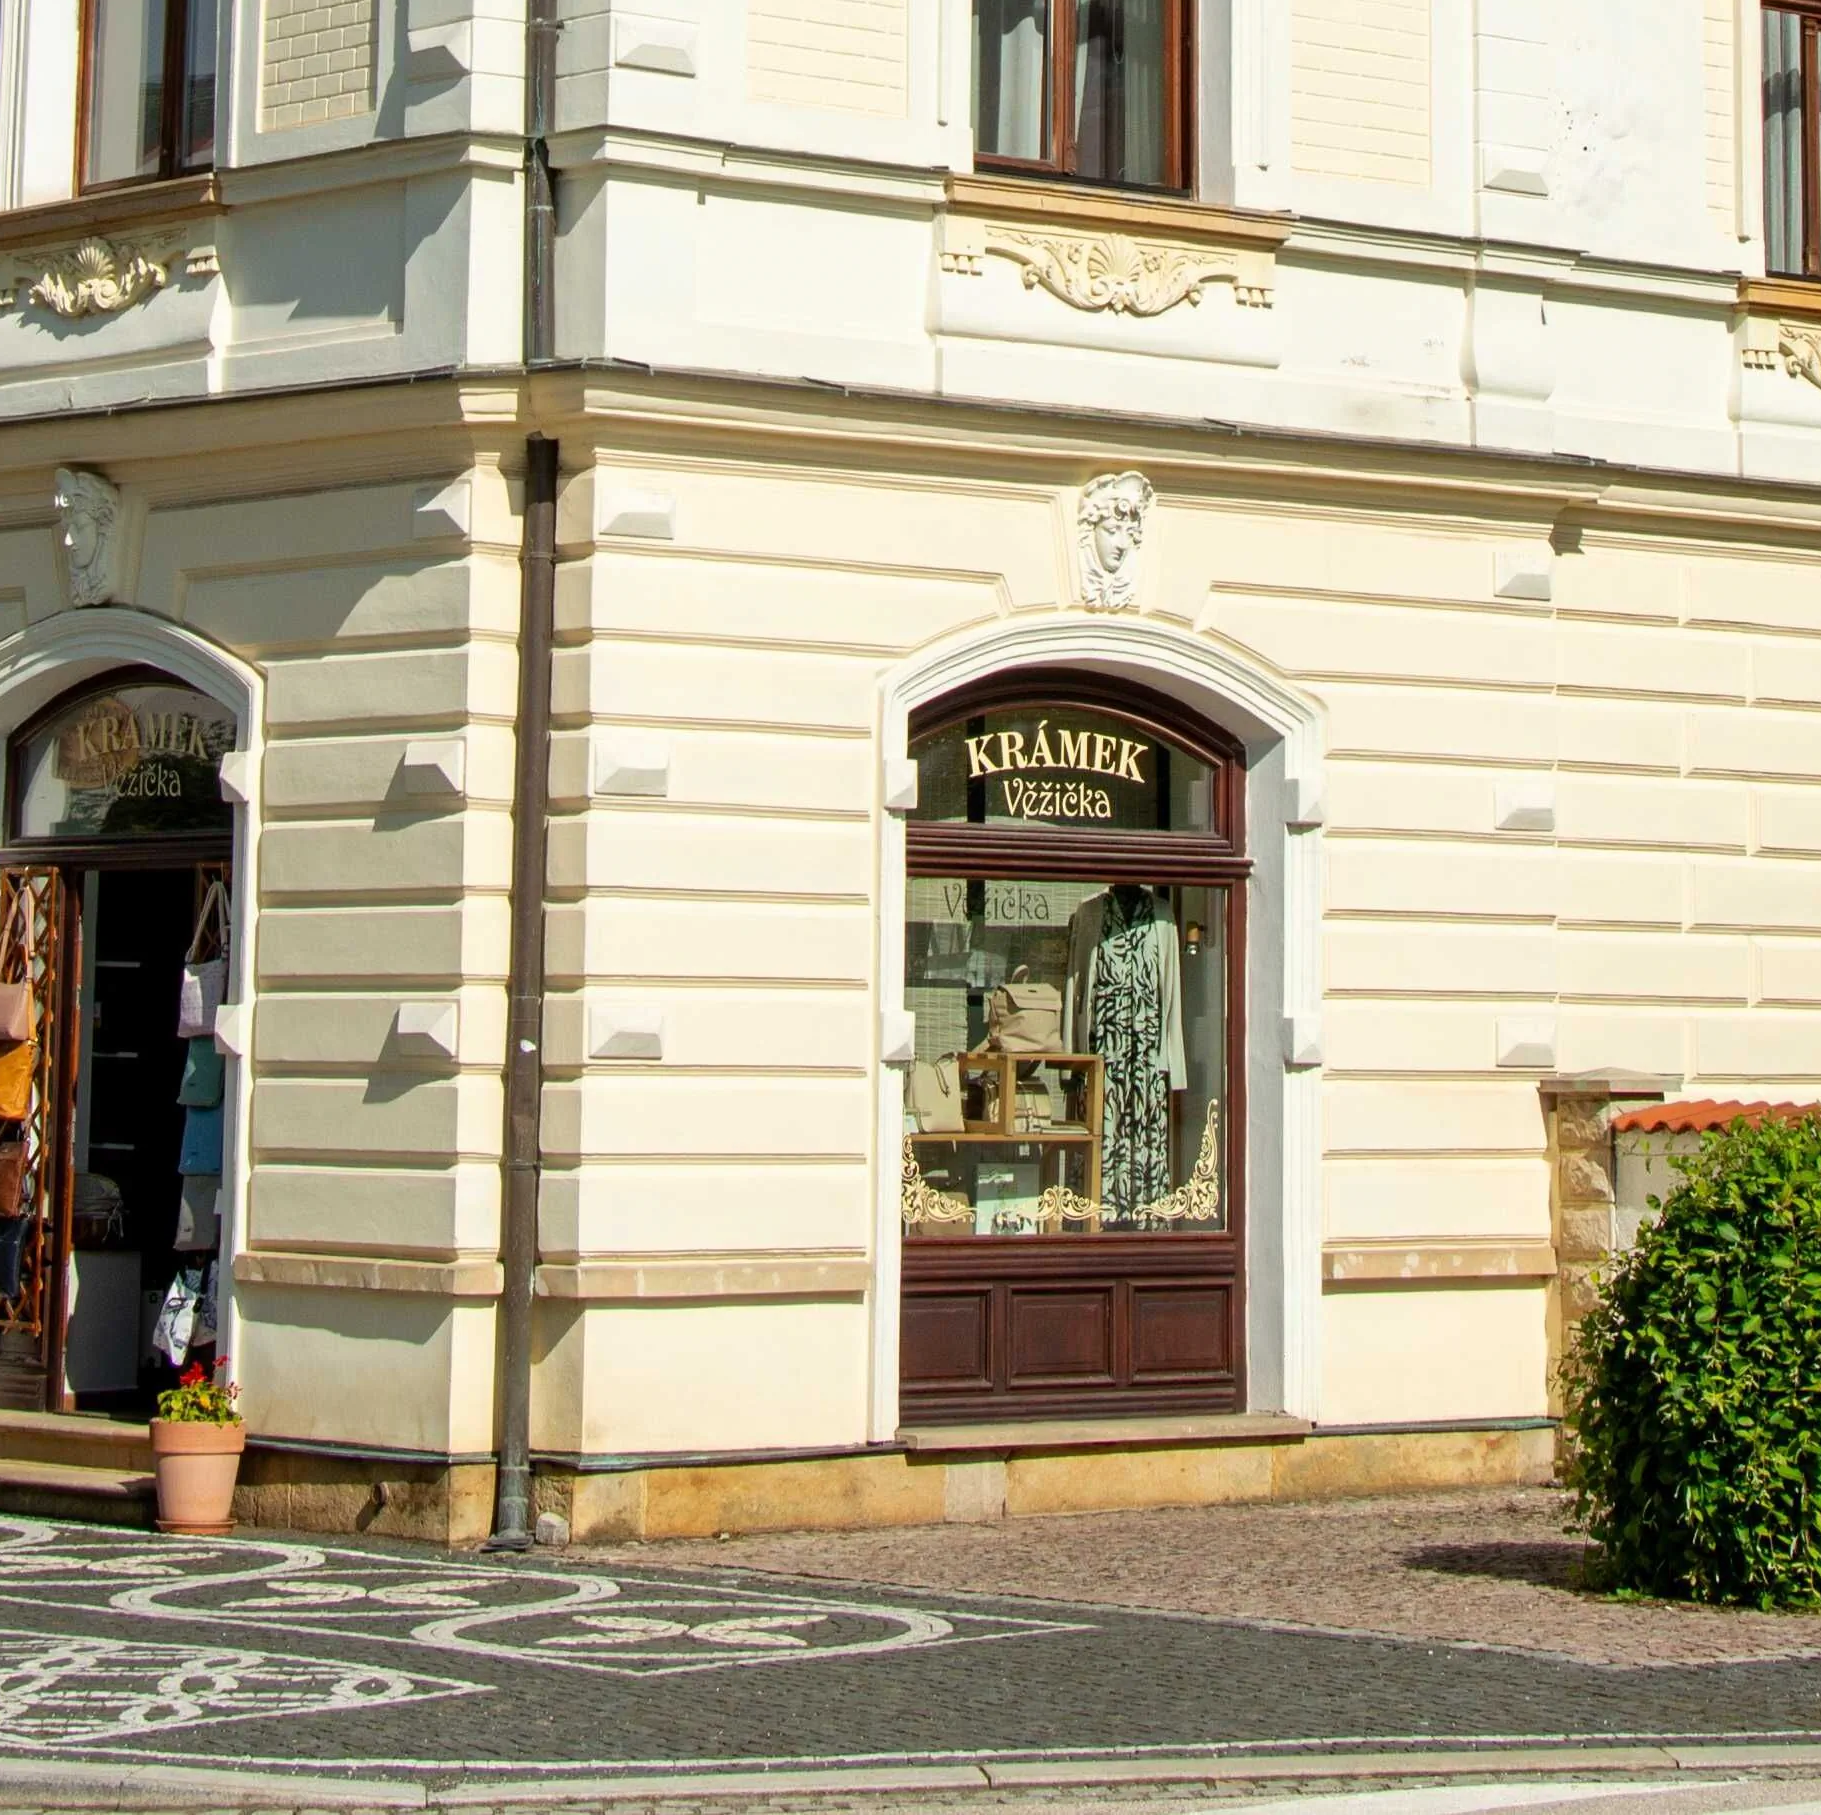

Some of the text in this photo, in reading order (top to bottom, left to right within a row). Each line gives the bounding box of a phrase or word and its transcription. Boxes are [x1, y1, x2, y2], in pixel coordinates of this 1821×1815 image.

[77, 704, 208, 760] KRÁMEK
[965, 720, 1148, 783] KRÁMEK
[1003, 778, 1112, 820] Věžička
